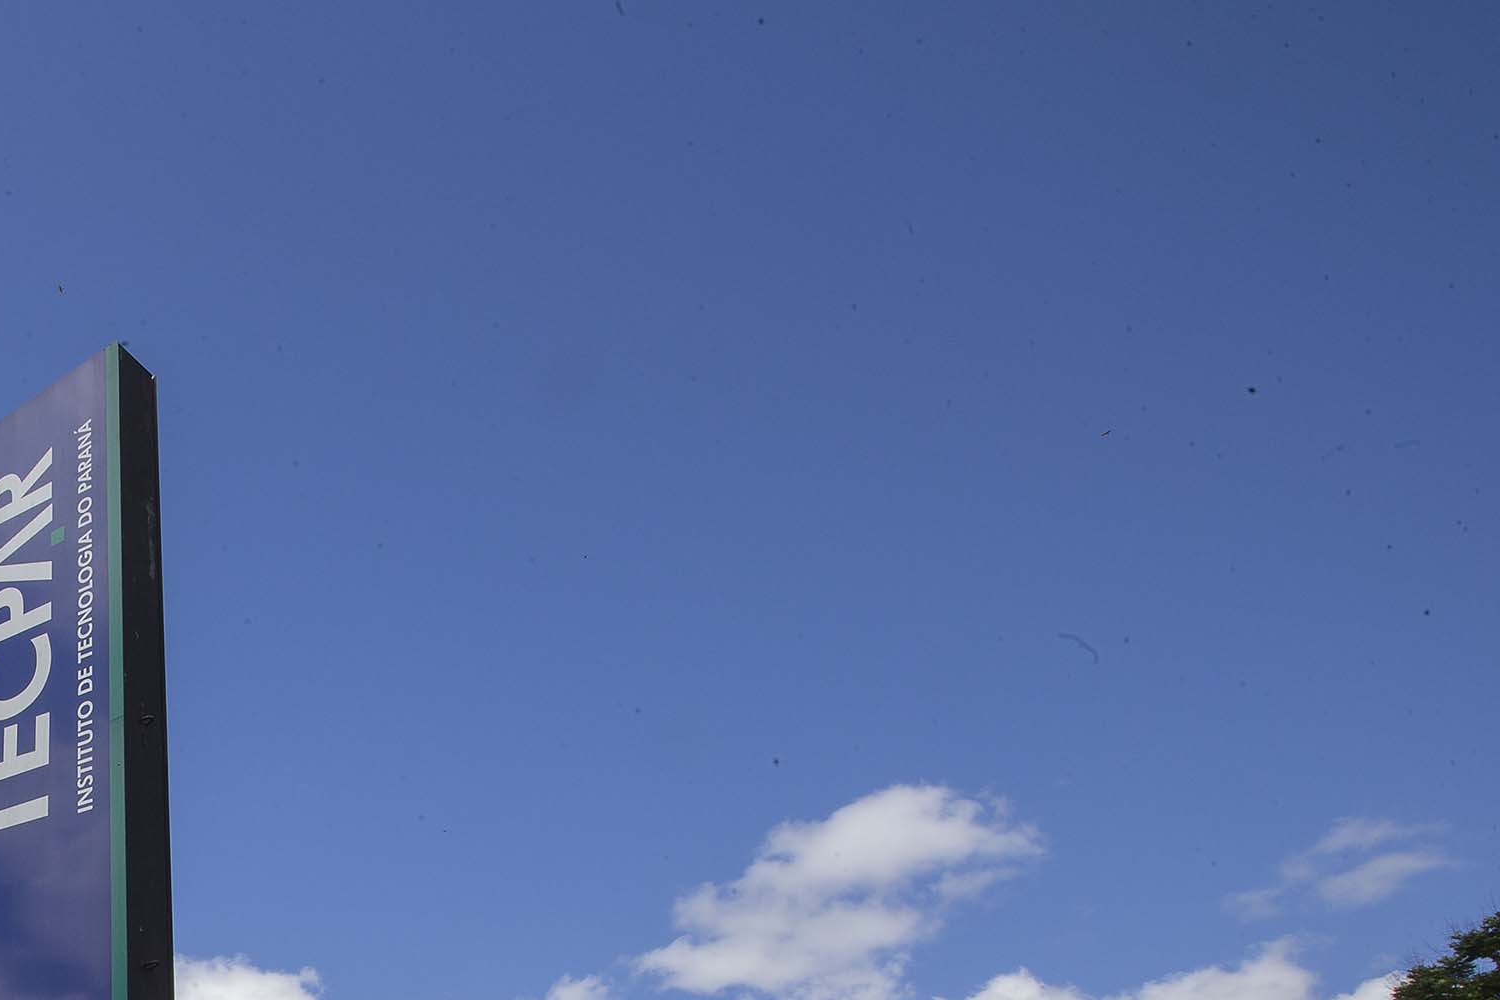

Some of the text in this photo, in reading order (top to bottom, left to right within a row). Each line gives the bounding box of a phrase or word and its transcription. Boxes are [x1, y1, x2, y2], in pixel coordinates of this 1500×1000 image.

[73, 418, 94, 813] INSTITUTO DE TECNOLOGIA DO PARANÁ
